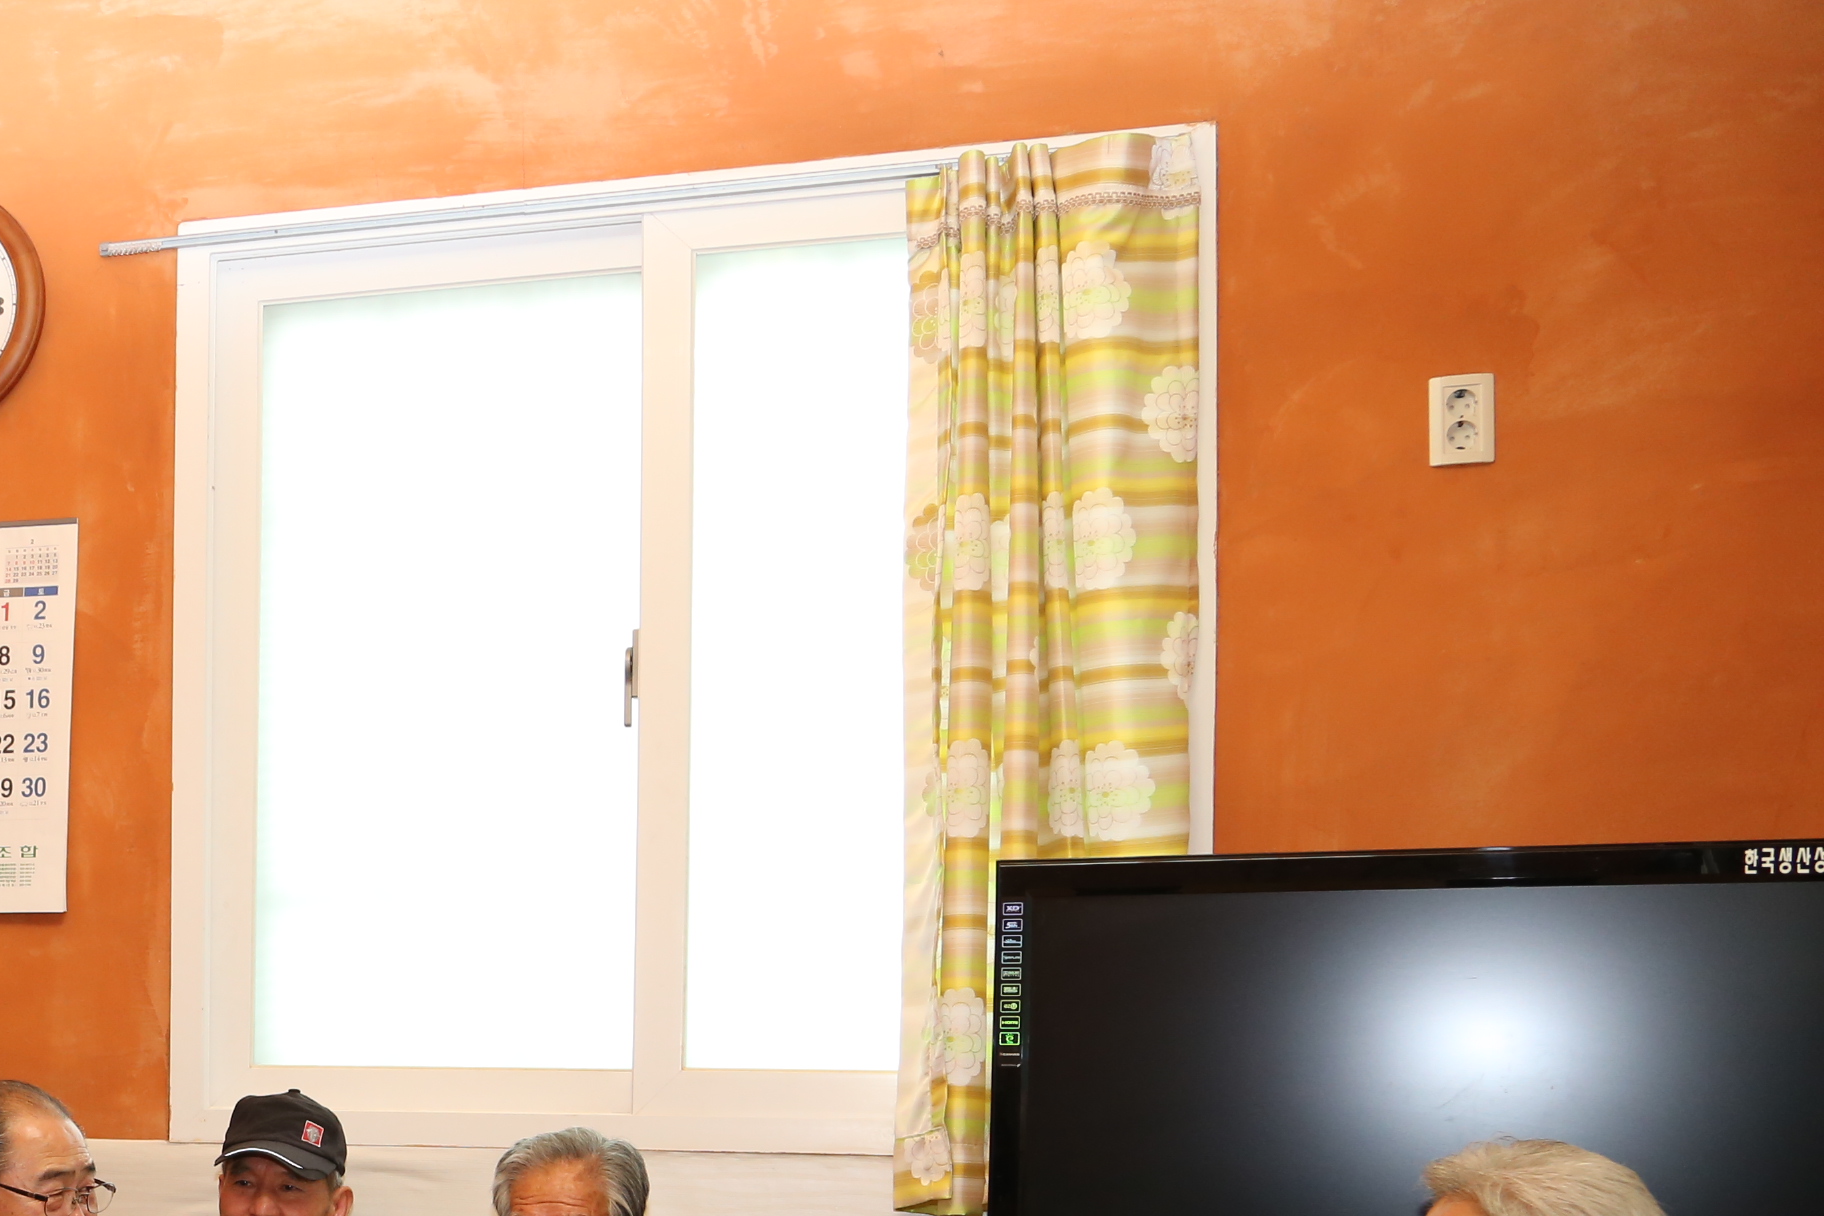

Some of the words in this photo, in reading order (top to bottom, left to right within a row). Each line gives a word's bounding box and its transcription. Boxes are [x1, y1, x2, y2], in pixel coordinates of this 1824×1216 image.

[1, 602, 9, 621] 1
[34, 600, 46, 620] 2
[33, 644, 44, 664] 9
[26, 688, 50, 708] 16
[23, 733, 48, 753] 23
[22, 777, 46, 797] 30
